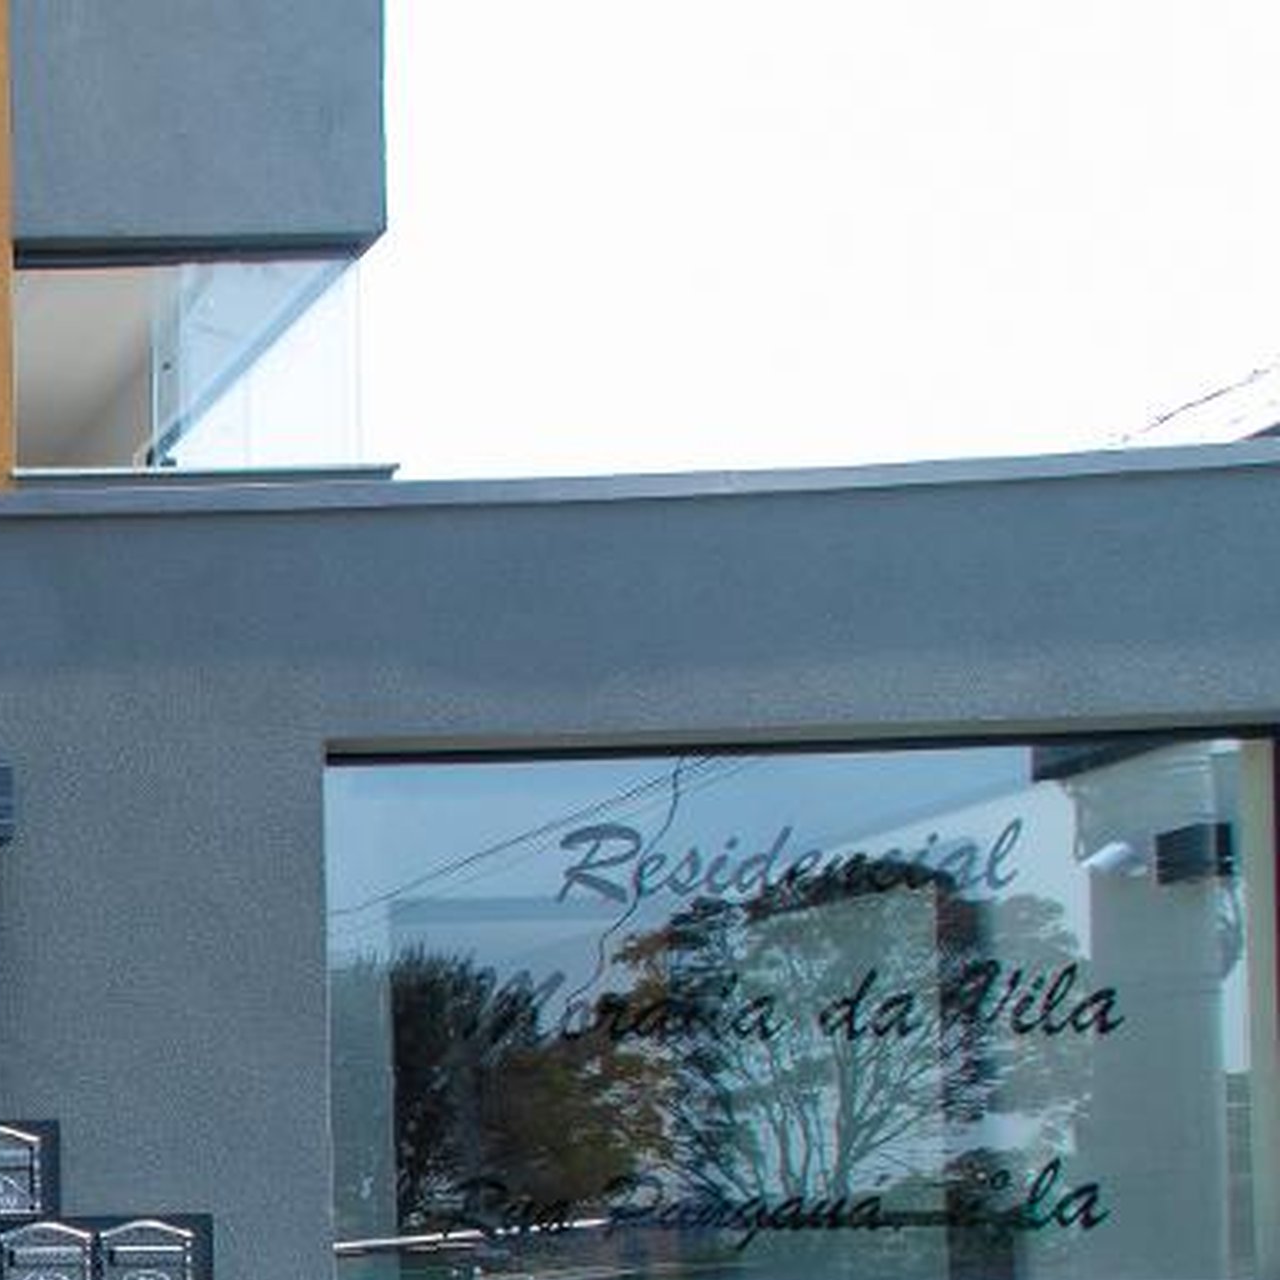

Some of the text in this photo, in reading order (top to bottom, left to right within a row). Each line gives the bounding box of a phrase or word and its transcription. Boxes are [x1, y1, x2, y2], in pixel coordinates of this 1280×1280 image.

[557, 817, 1023, 905] Residencial
[818, 968, 924, 1042] da
[953, 958, 1126, 1036] Vila
